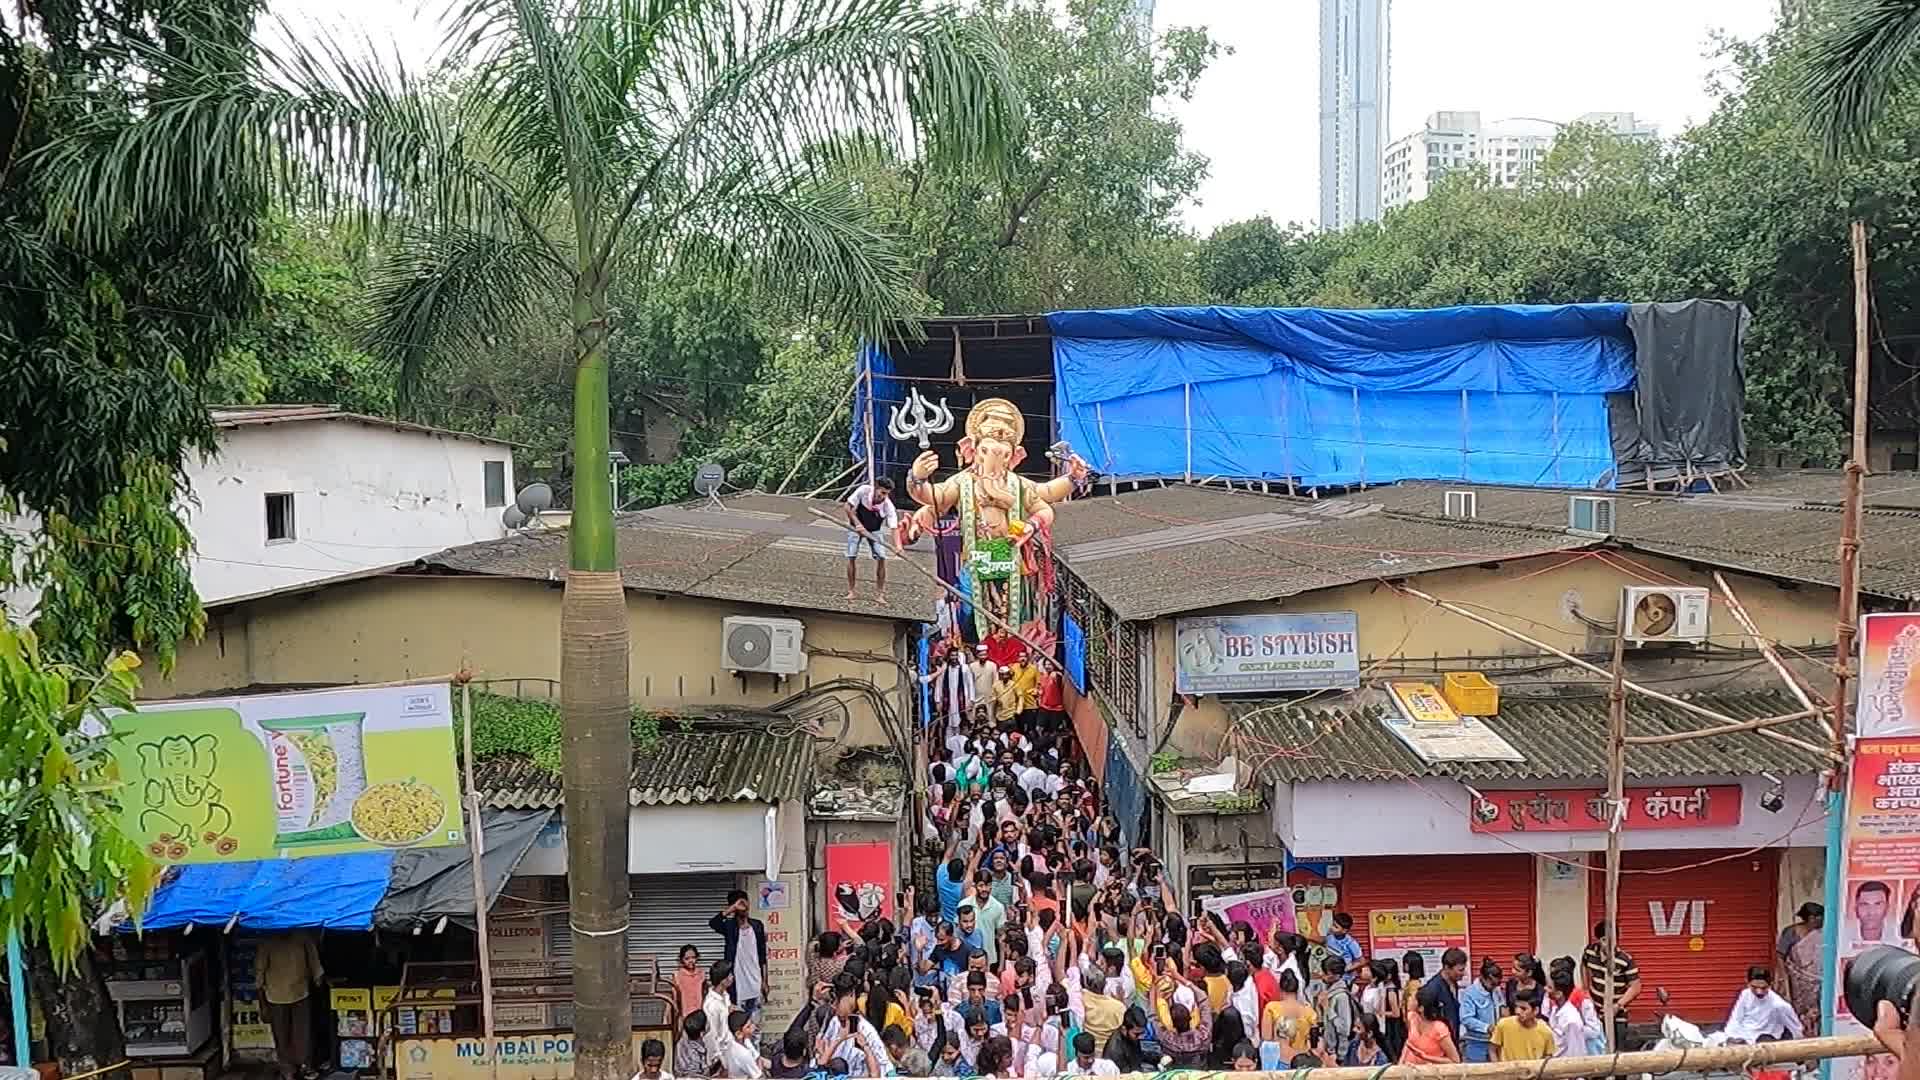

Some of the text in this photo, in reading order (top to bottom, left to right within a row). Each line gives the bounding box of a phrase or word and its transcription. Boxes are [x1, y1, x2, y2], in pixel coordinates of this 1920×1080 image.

[1225, 631, 1353, 657] BE STYLISH
[276, 744, 294, 811] fortune
[1648, 900, 1706, 936] VI
